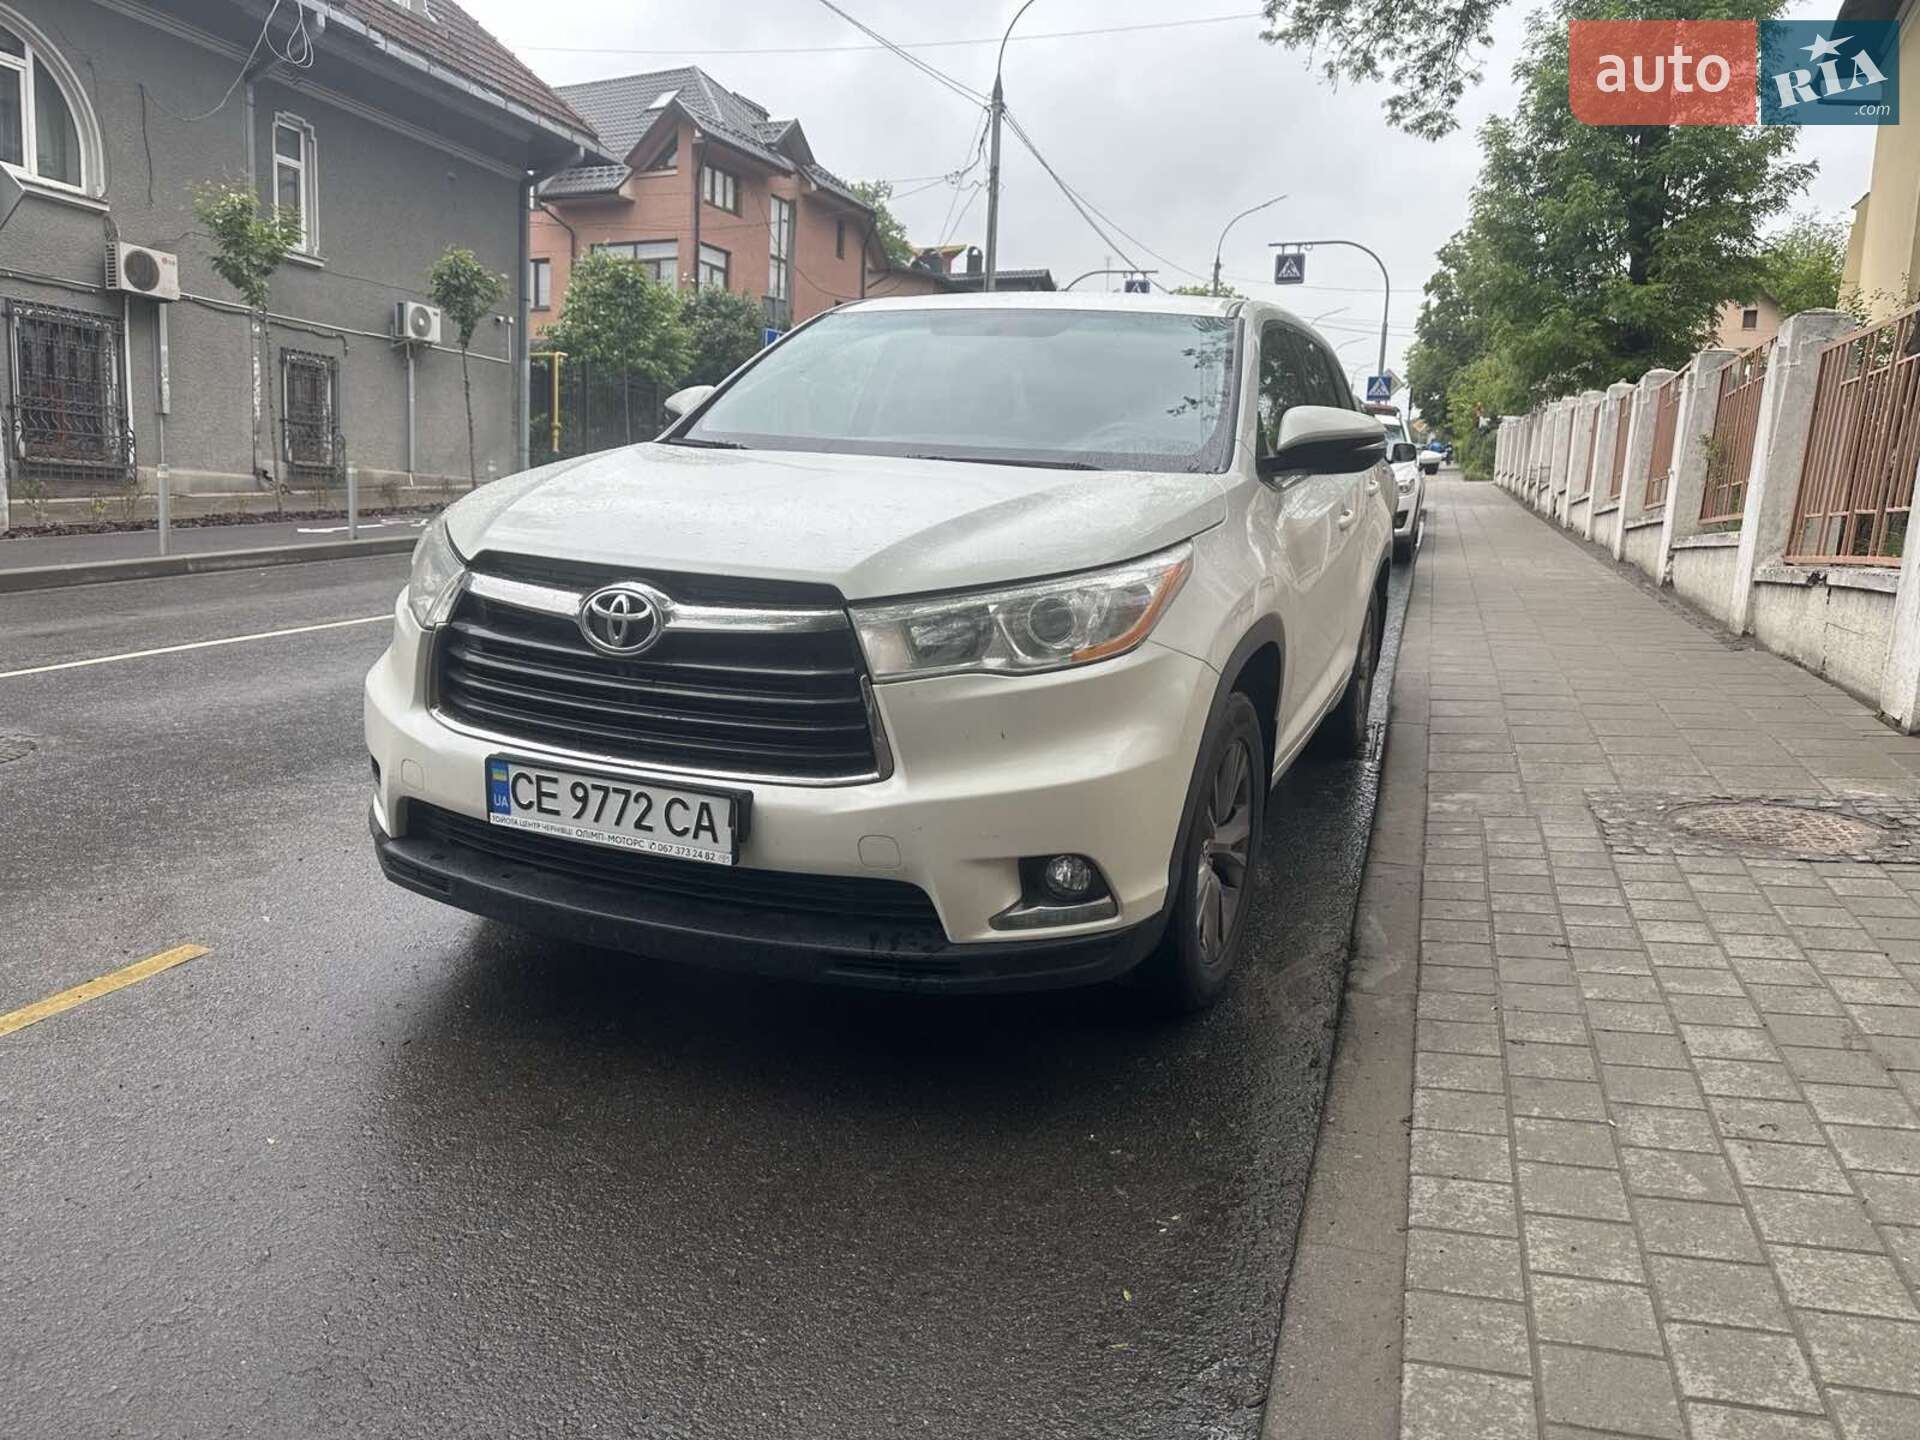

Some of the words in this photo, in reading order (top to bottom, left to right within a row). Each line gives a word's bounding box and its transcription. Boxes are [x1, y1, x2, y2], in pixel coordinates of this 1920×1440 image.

[493, 792, 509, 807] UA
[510, 771, 561, 816] CE
[569, 781, 654, 832] 9772
[664, 797, 719, 844] CA
[674, 846, 691, 857] 373
[692, 849, 703, 859] 24
